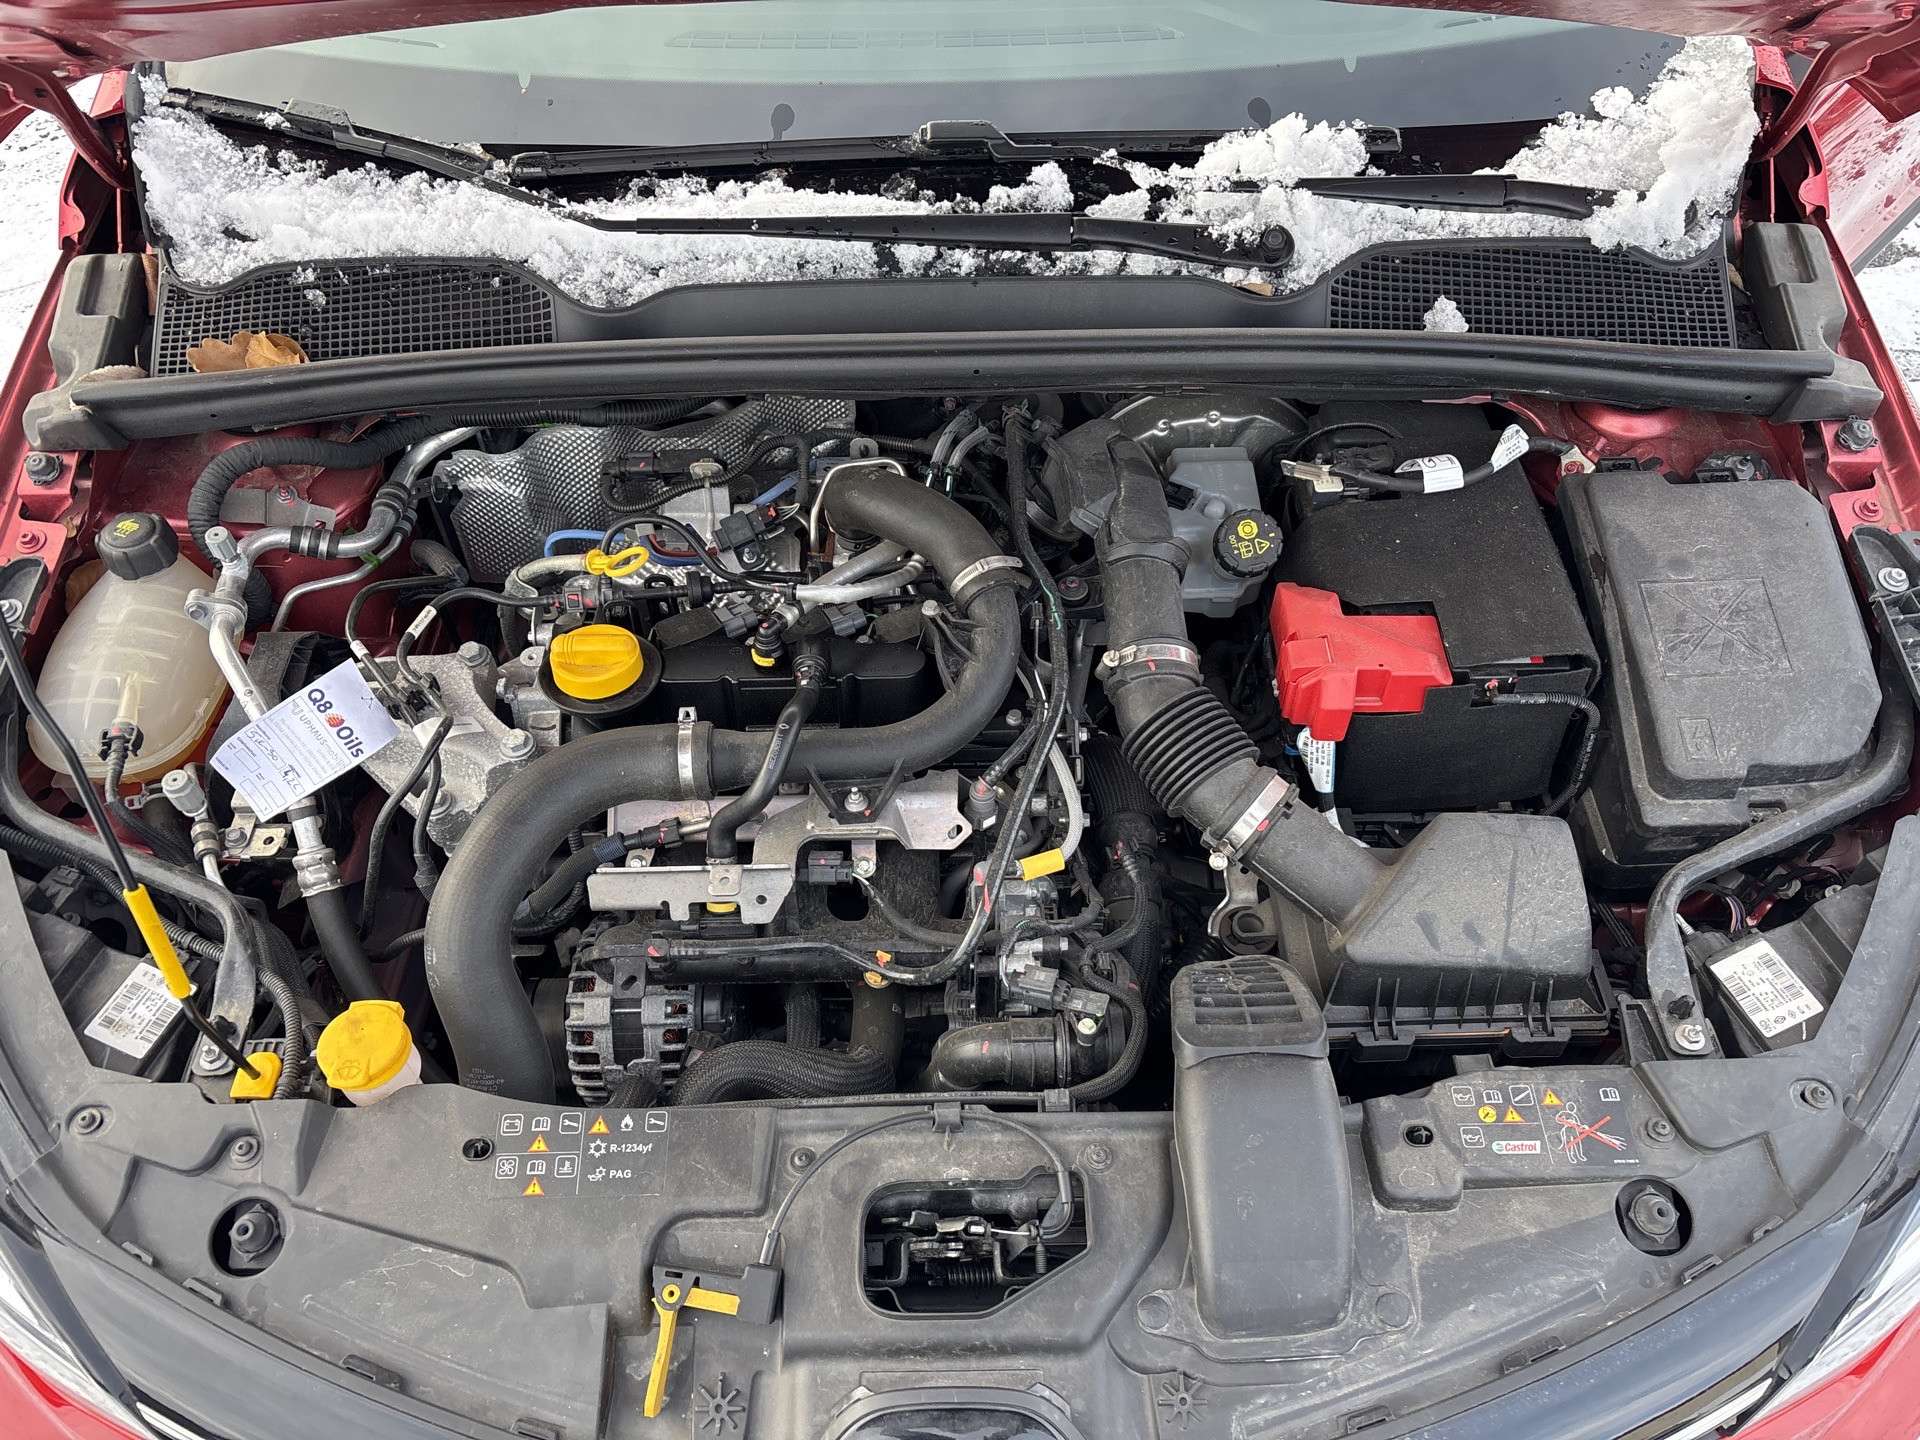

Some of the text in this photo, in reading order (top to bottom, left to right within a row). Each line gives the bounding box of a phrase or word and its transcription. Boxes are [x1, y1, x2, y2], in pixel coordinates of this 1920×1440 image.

[308, 689, 333, 713] Q8
[336, 726, 364, 758] Oils
[610, 1143, 653, 1154] R-1234yf
[1504, 1142, 1537, 1152] Castrol
[609, 1169, 632, 1179] PAG
